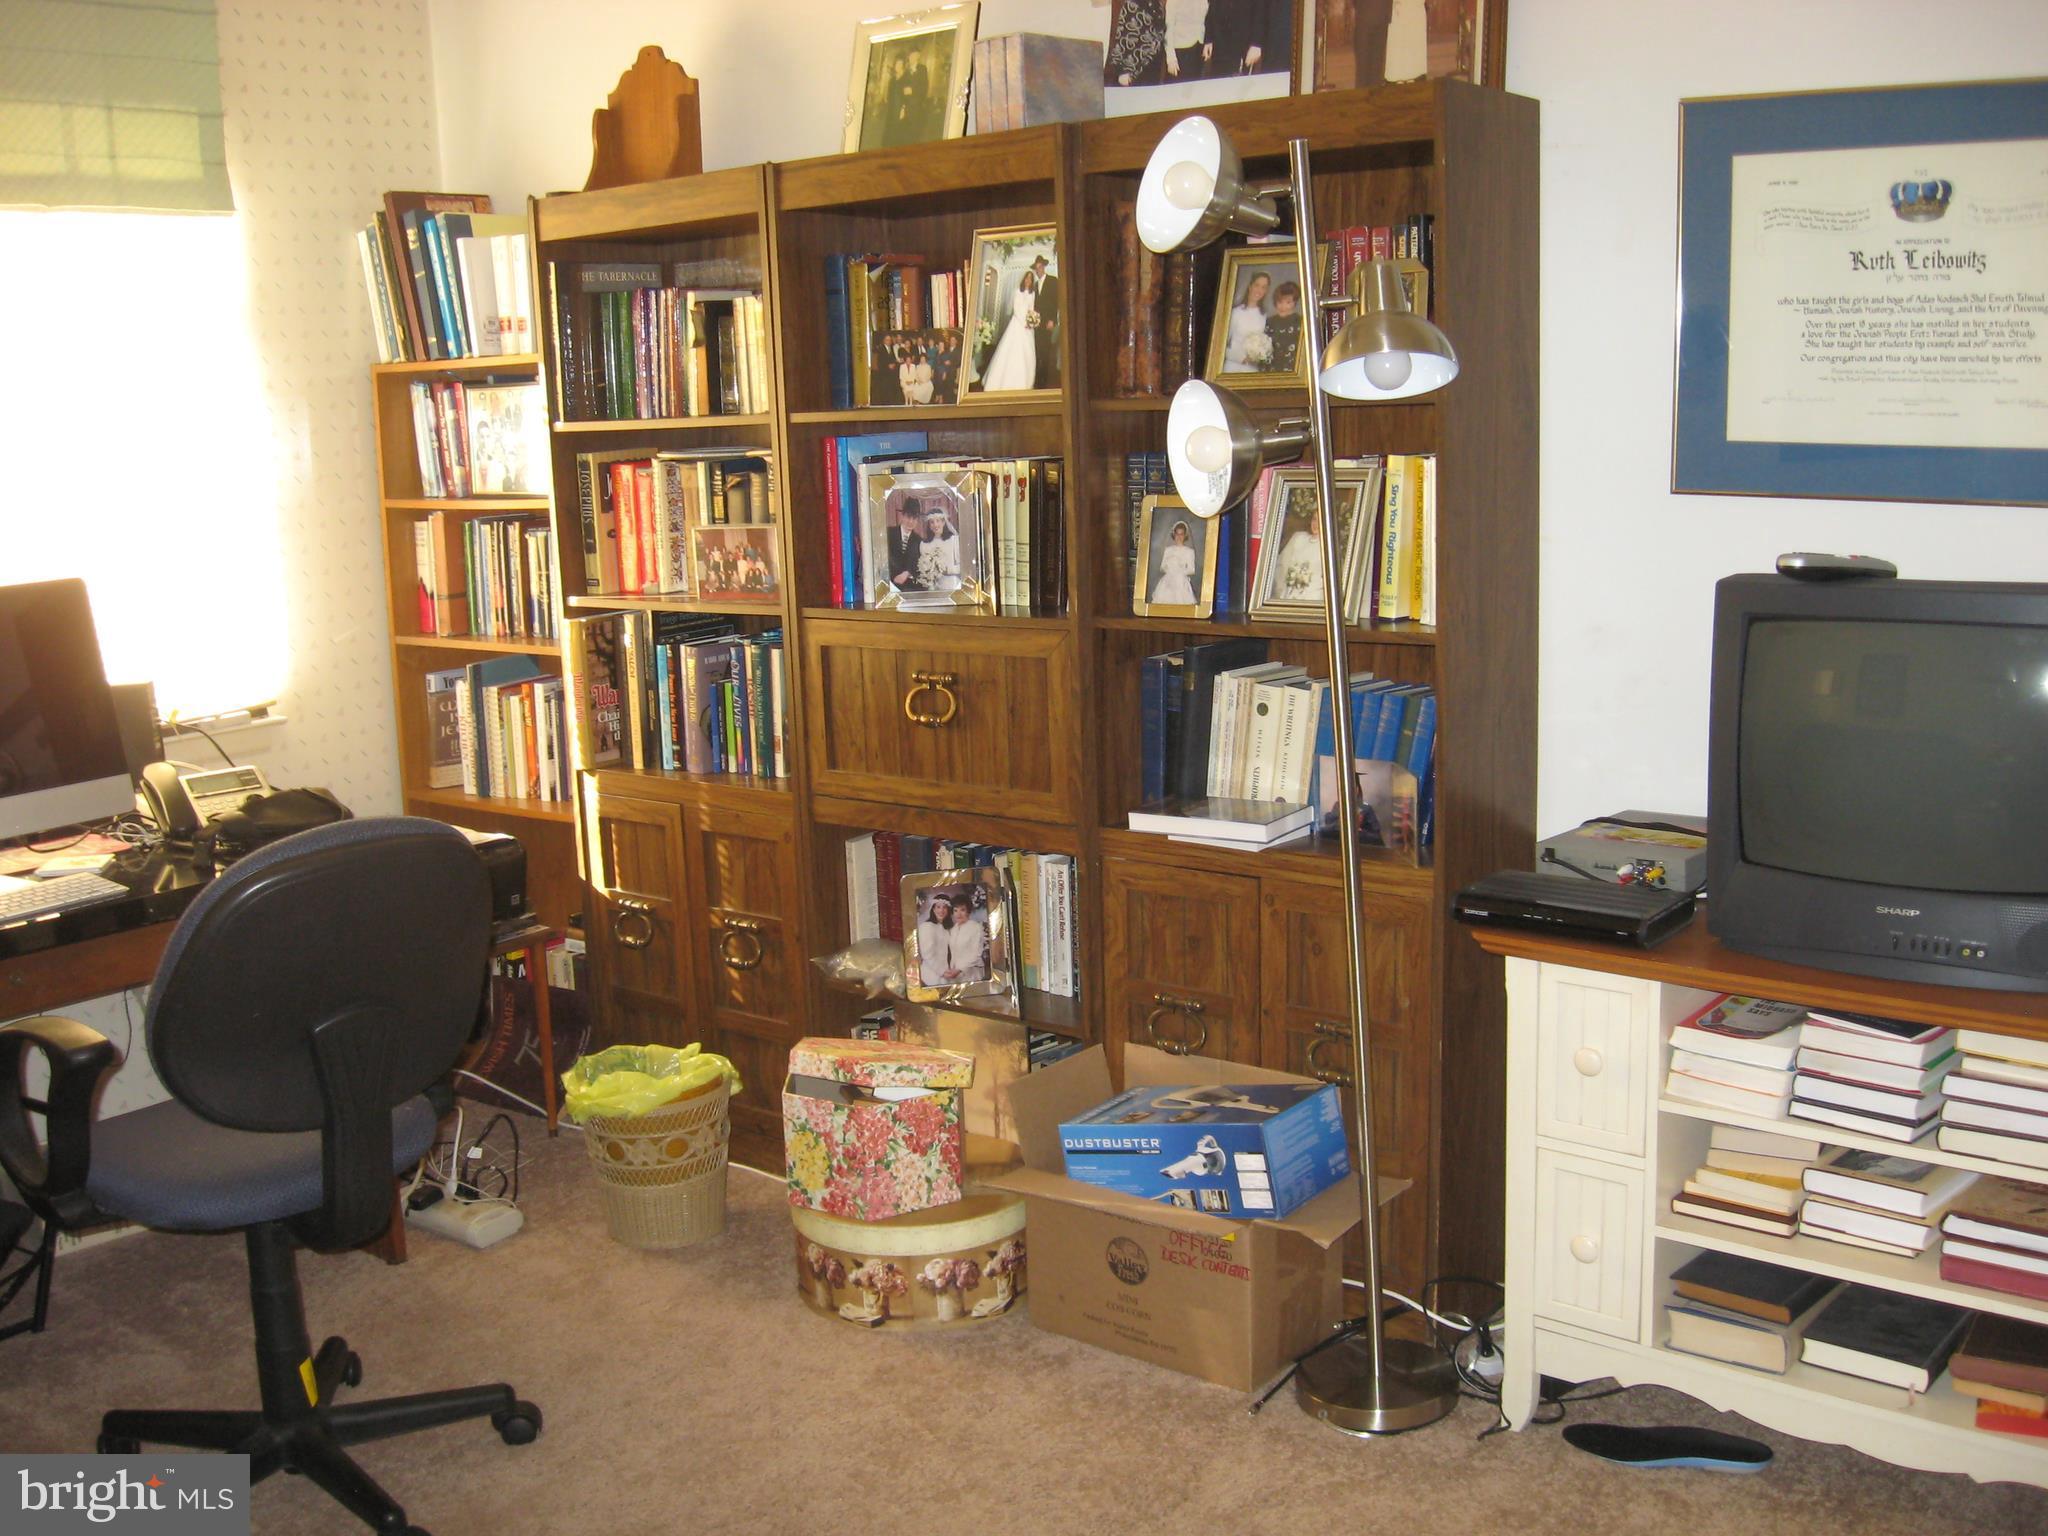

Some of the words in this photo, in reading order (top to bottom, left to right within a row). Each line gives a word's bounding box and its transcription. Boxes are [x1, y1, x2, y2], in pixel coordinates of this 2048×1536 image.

[1849, 249, 1895, 271] Ruth
[1903, 248, 1987, 275] Leibowitz
[599, 271, 657, 281] TABERNACLE
[1812, 296, 1836, 307] taught
[1839, 296, 1851, 304] the
[1852, 296, 1869, 306] girls
[1871, 296, 1884, 304] and
[1825, 320, 1836, 328] the
[1911, 320, 1924, 328] has
[1989, 319, 2030, 328] students
[1808, 330, 1822, 338] love
[1825, 330, 1837, 338] for
[1840, 330, 1851, 338] the
[1837, 339, 1861, 350] taught
[1879, 339, 1913, 348] students
[1817, 354, 1866, 364] congregation
[1869, 354, 1883, 362] and
[580, 469, 593, 524] JOSEPHUS
[1389, 484, 1399, 507] Sing
[1389, 508, 1398, 528] You
[1386, 531, 1397, 585] Righteous
[1283, 708, 1294, 747] WRITINGS
[1875, 906, 1920, 917] SHARP
[1064, 1137, 1160, 1149] DUSTBUSTER
[1160, 1245, 1199, 1270] DESK
[1201, 1259, 1252, 1281] CONTENTS
